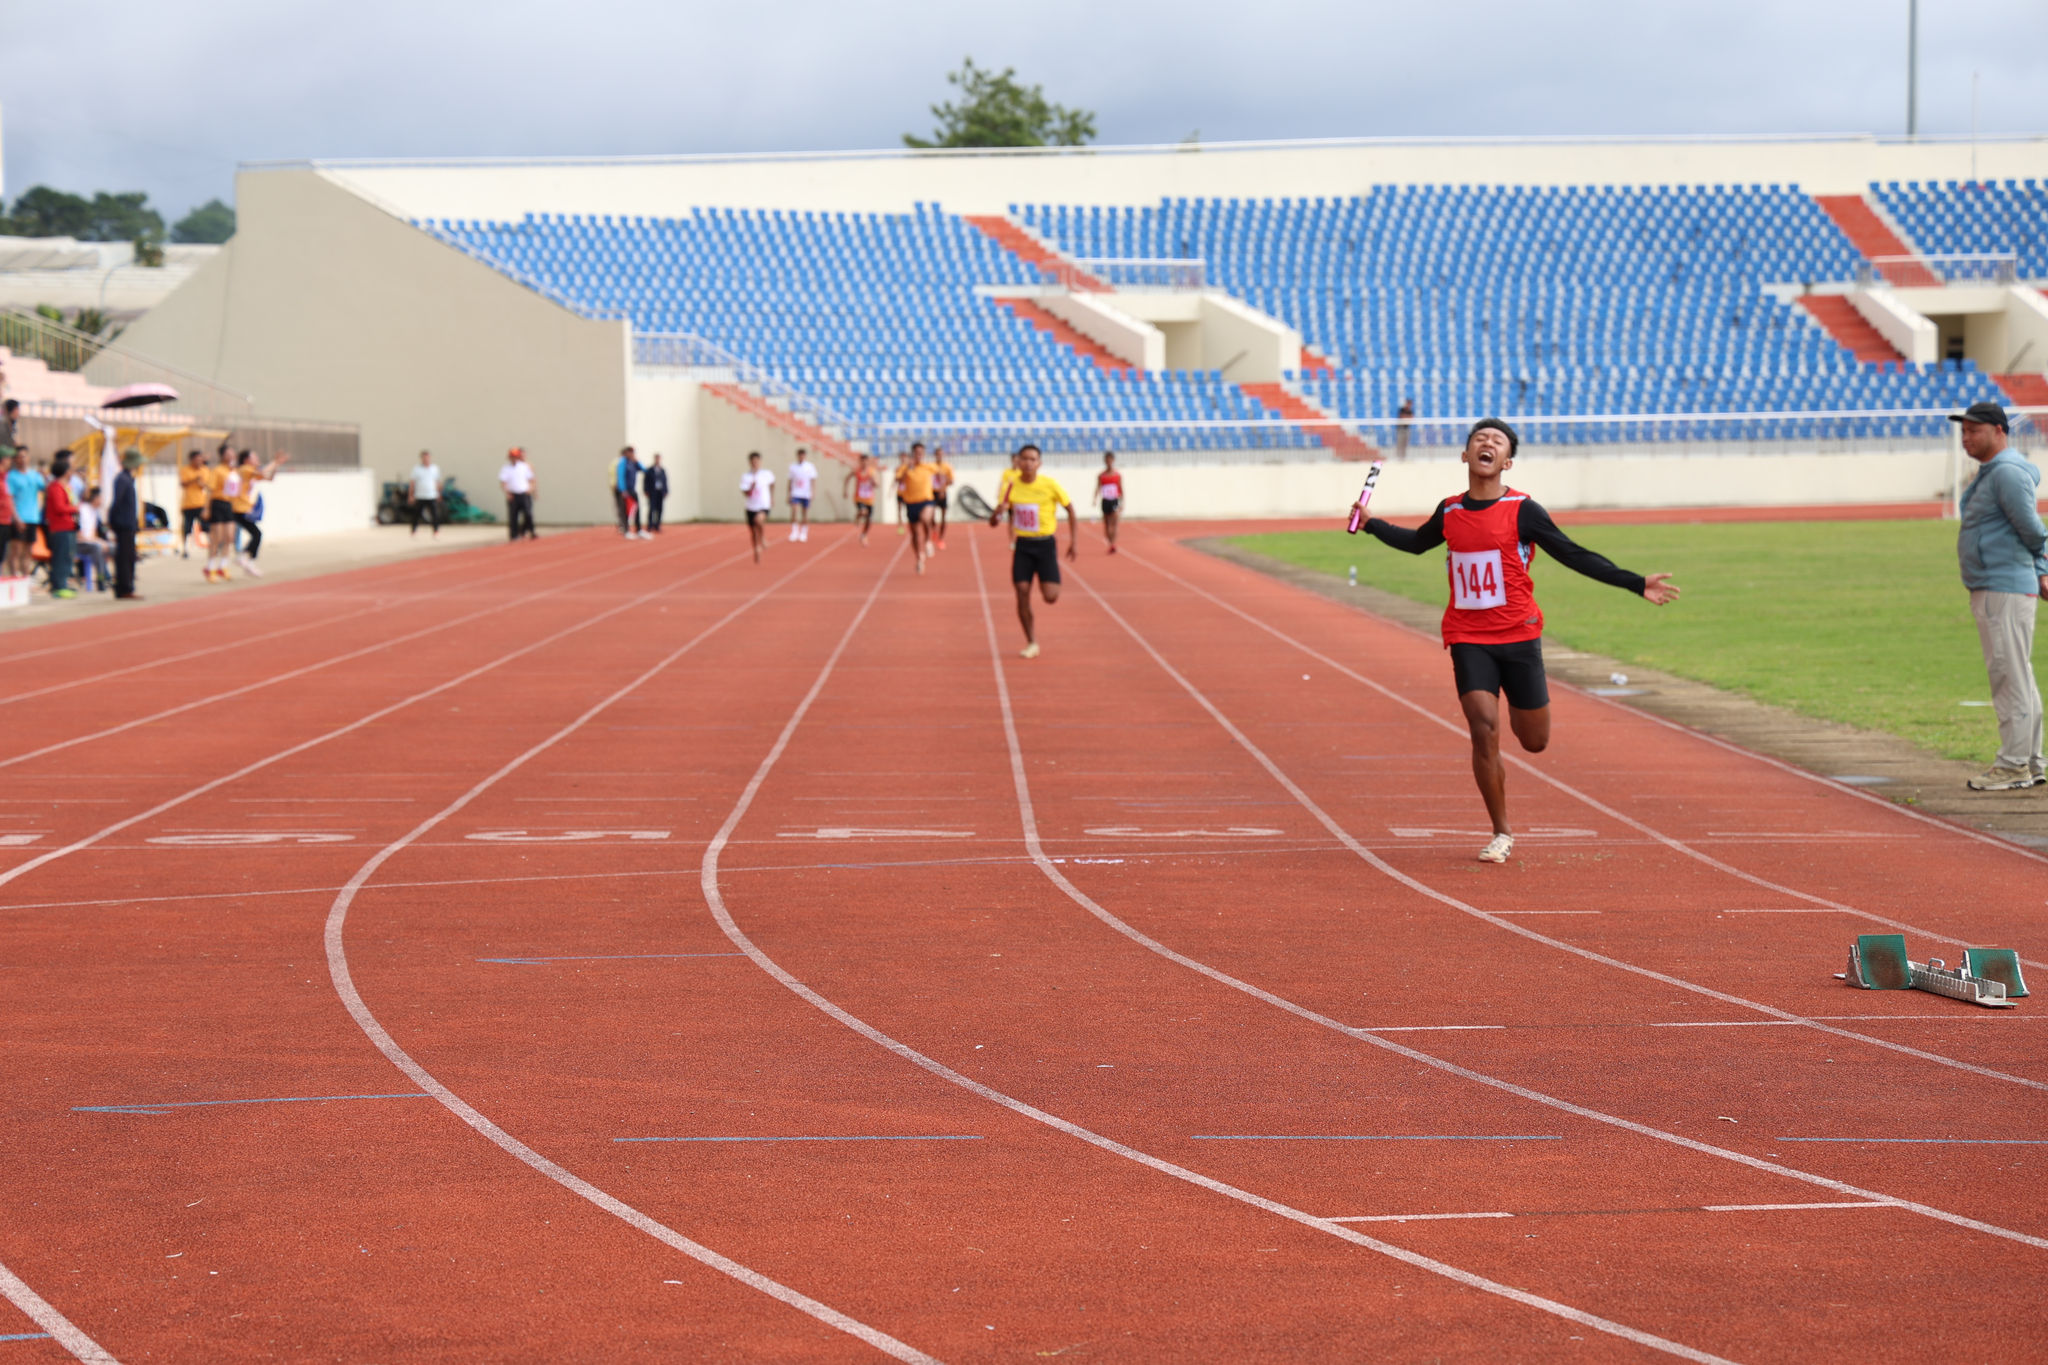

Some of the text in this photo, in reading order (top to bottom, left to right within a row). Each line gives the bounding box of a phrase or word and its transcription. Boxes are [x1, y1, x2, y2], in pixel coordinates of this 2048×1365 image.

[1457, 562, 1497, 599] 144
[464, 830, 672, 841] 5
[776, 828, 976, 839] 4
[1083, 827, 1285, 837] 3
[144, 833, 356, 845] 6
